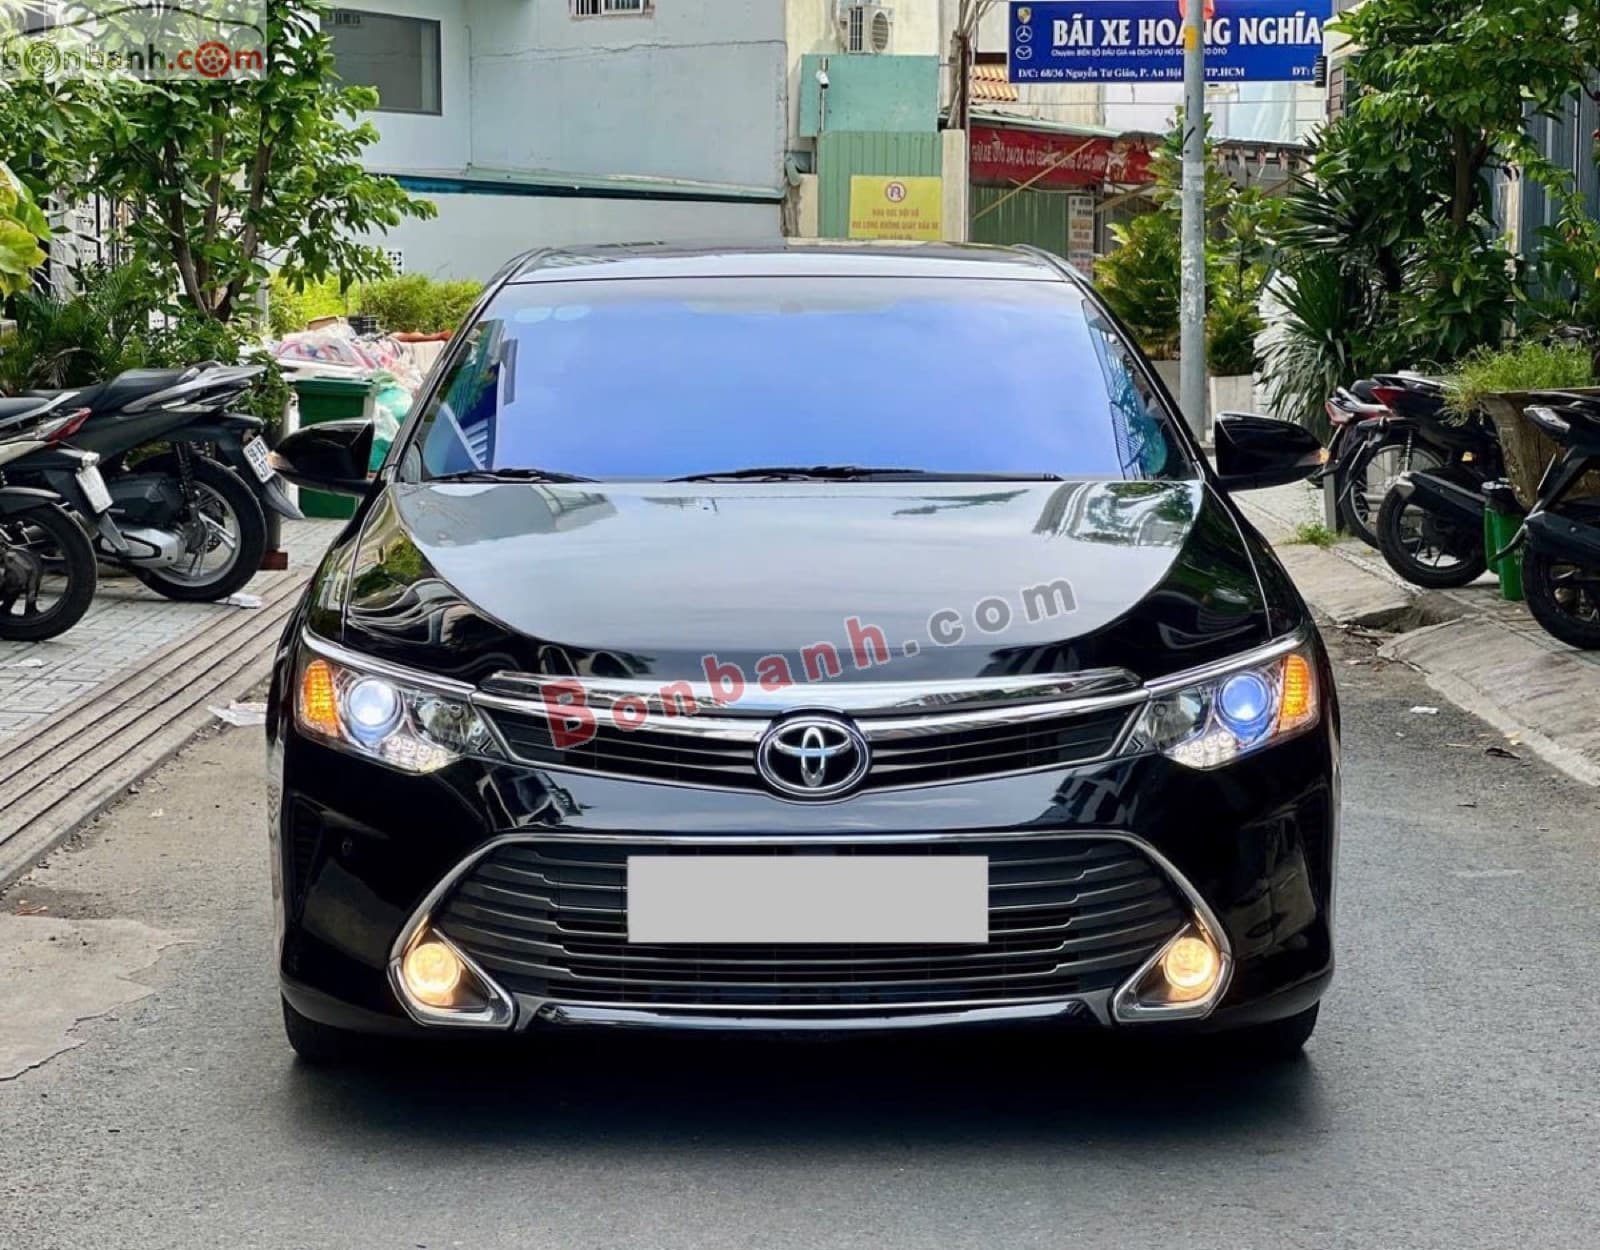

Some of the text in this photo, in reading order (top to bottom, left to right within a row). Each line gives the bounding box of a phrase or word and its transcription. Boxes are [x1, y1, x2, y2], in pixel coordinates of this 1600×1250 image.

[1053, 11, 1322, 46] BÃI XE HONG NGHĨA
[1152, 68, 1164, 77] An
